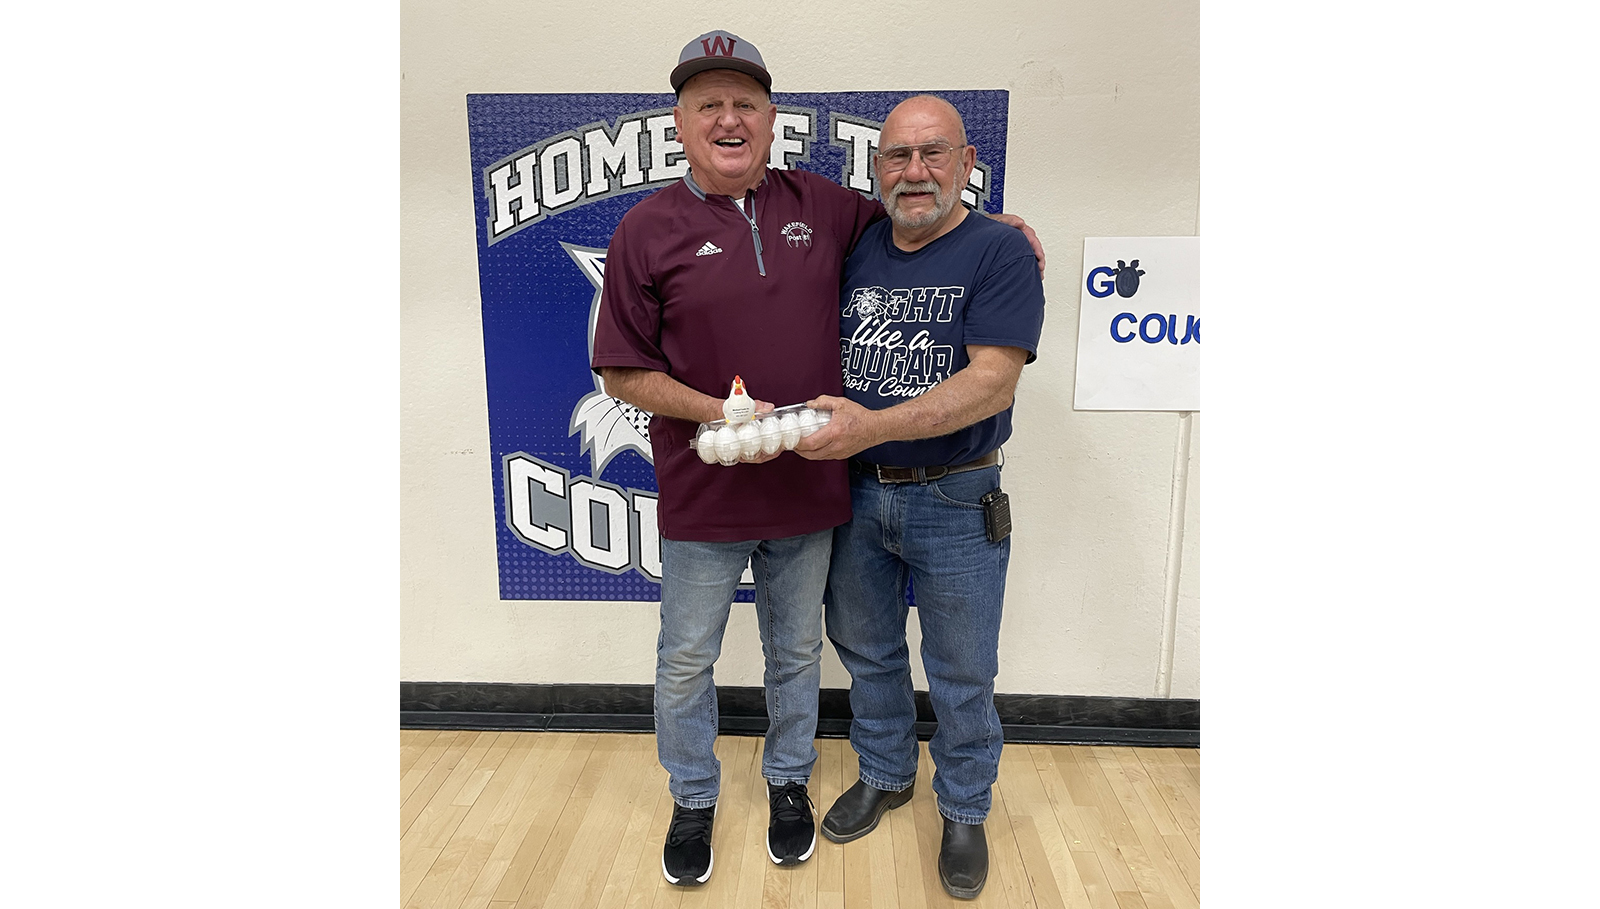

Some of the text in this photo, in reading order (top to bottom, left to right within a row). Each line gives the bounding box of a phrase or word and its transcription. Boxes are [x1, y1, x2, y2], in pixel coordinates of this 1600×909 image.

[701, 36, 737, 57] W
[490, 114, 691, 236] HOME
[781, 221, 813, 235] WAKEFIELD
[696, 247, 723, 257] adidas
[851, 316, 935, 351] like a
[1110, 312, 1200, 346] COU
[840, 338, 954, 385] COUGAR
[878, 377, 940, 397] Count
